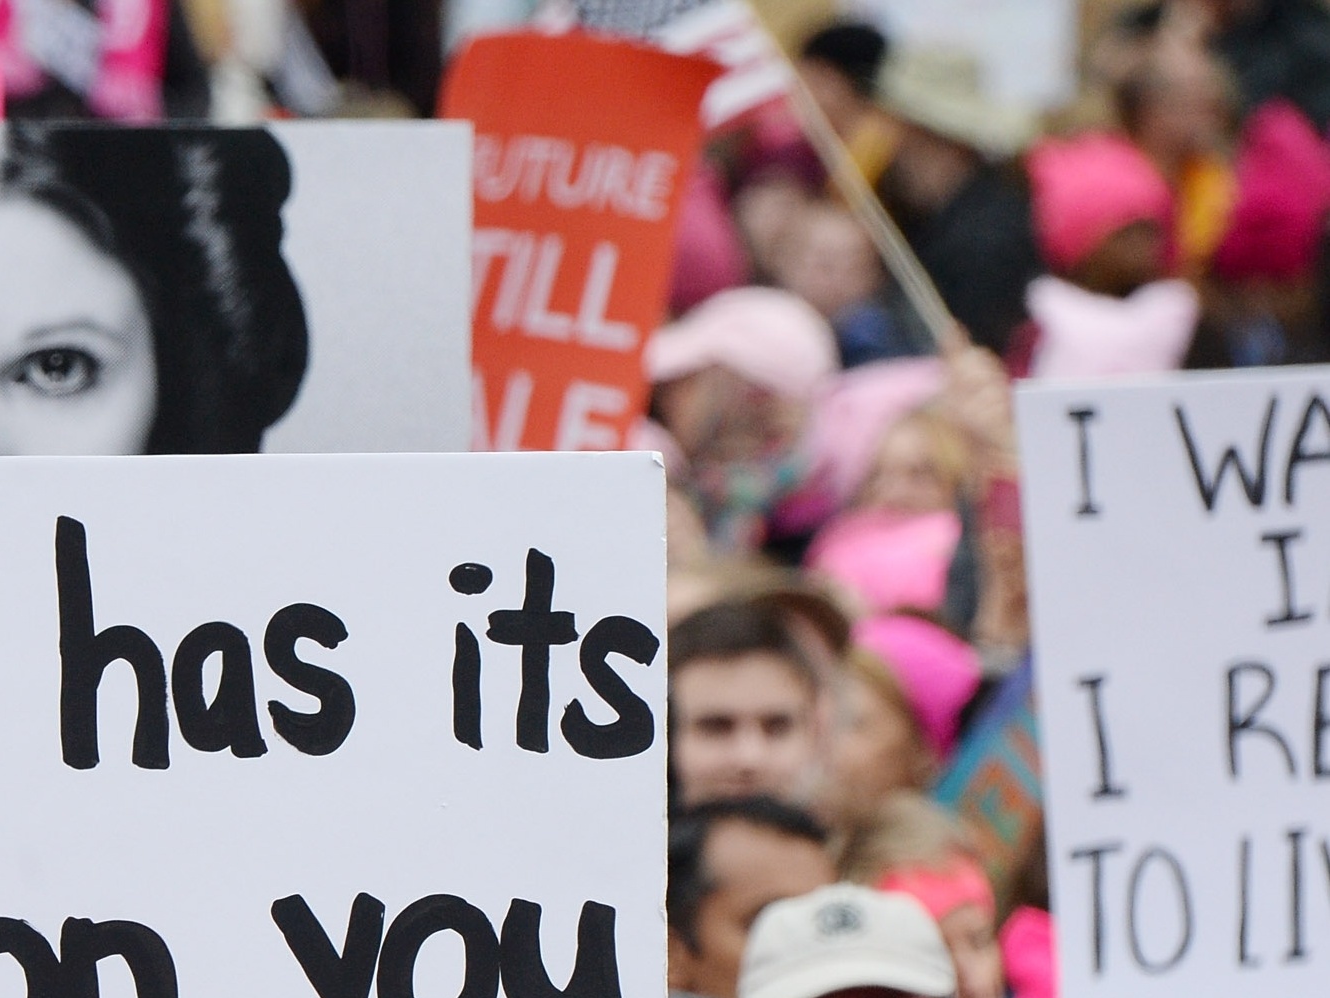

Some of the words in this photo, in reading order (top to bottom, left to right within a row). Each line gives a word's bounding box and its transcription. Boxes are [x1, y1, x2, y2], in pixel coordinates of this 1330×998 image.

[473, 133, 678, 221] UTURE
[1069, 408, 1099, 516] I
[56, 516, 356, 771] has
[449, 548, 659, 759] its
[1077, 673, 1126, 800] I
[1070, 843, 1195, 976] TO
